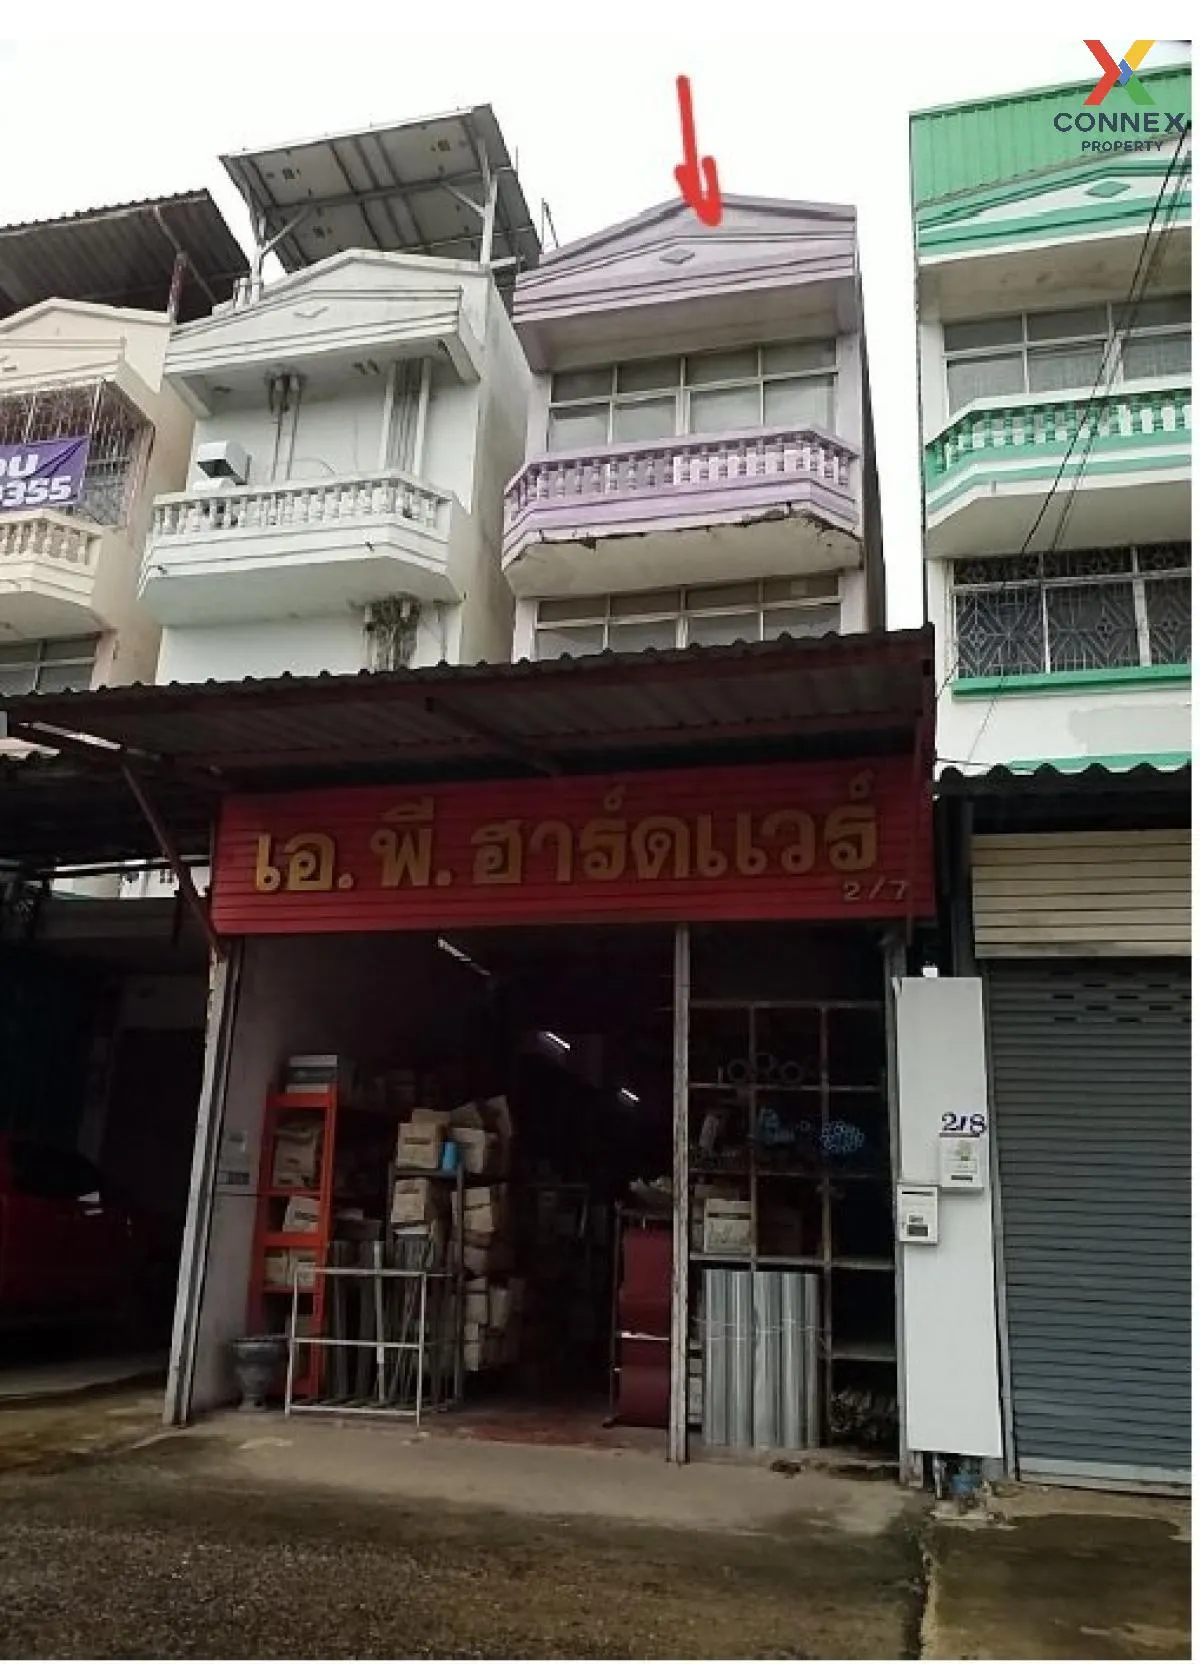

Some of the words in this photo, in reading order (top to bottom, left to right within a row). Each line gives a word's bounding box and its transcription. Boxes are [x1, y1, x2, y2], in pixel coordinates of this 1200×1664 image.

[255, 832, 355, 891] เอ.
[370, 796, 451, 887] พี.
[470, 768, 878, 885] ฮาร์ดแวร์
[843, 875, 911, 901] 2/7
